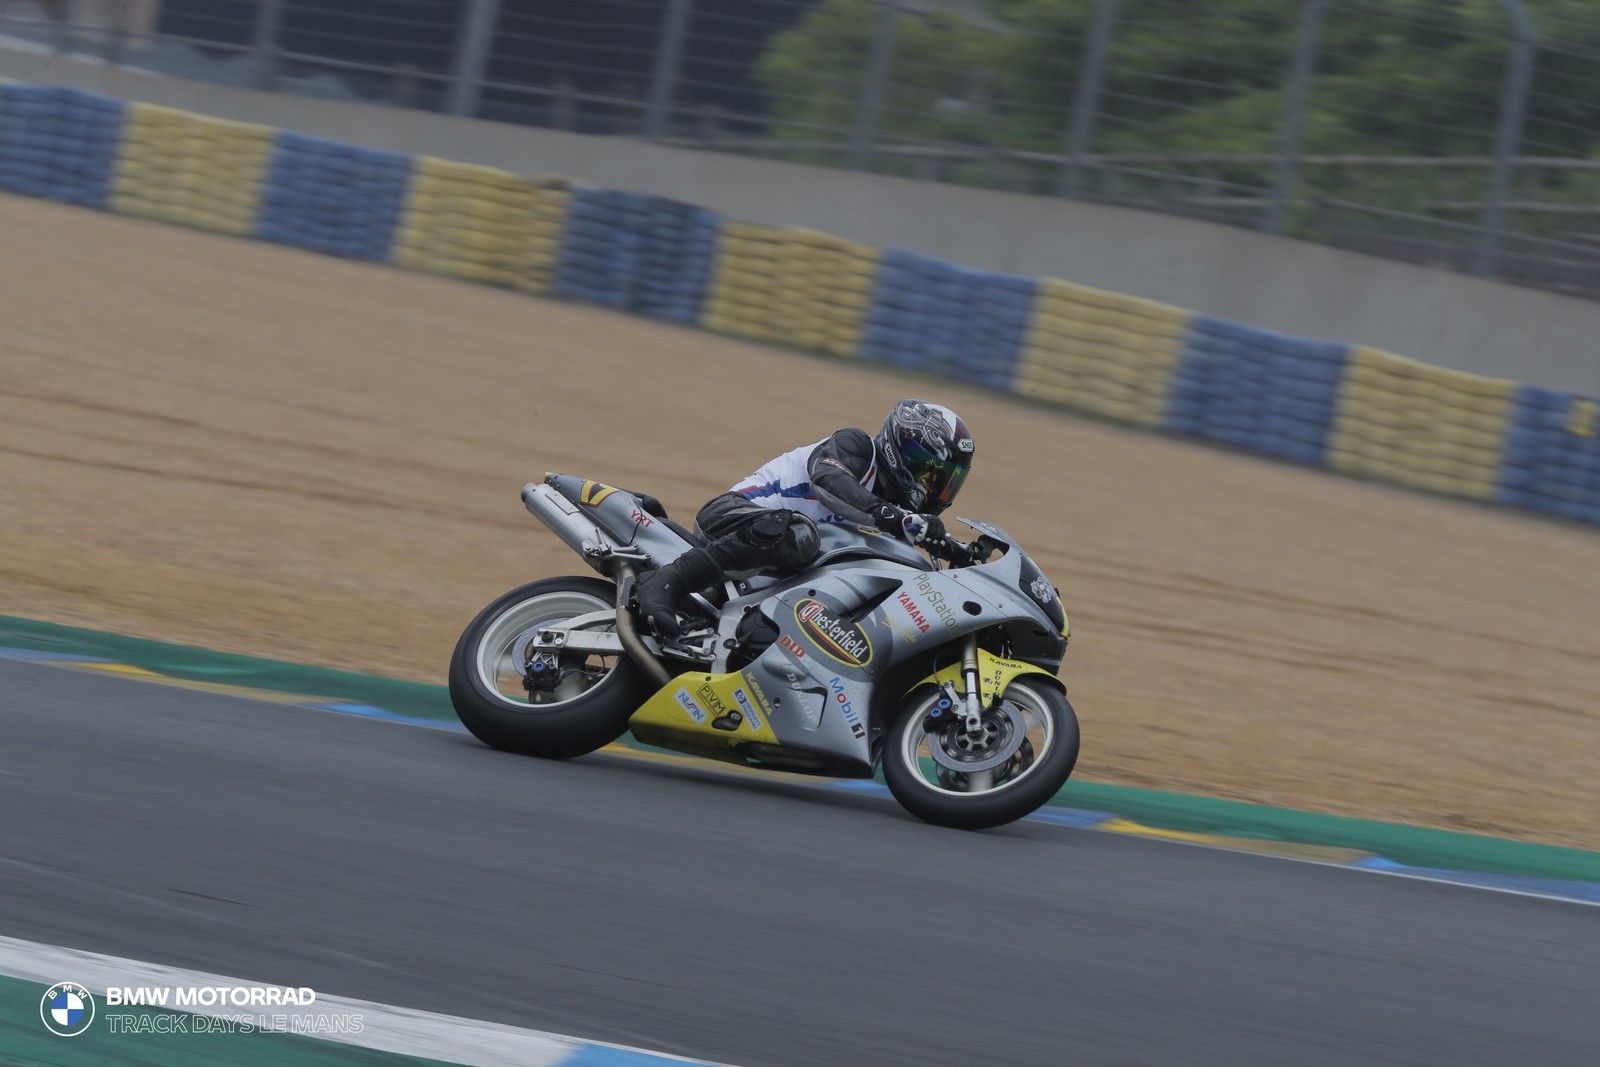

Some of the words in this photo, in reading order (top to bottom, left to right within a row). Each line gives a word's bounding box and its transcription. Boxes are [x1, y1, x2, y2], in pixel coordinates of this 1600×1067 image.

[885, 445, 896, 466] SHOEI
[961, 441, 973, 450] SHOE
[630, 509, 655, 528] YRT
[897, 591, 931, 634] YAMAHA
[913, 572, 961, 635] PlayStation
[798, 601, 868, 659] Chesterfield
[779, 635, 807, 658] DID
[786, 672, 817, 722] DUNLOP
[994, 669, 1002, 697] DUNLO
[701, 684, 725, 714] PVM
[829, 676, 859, 723] Mobil
